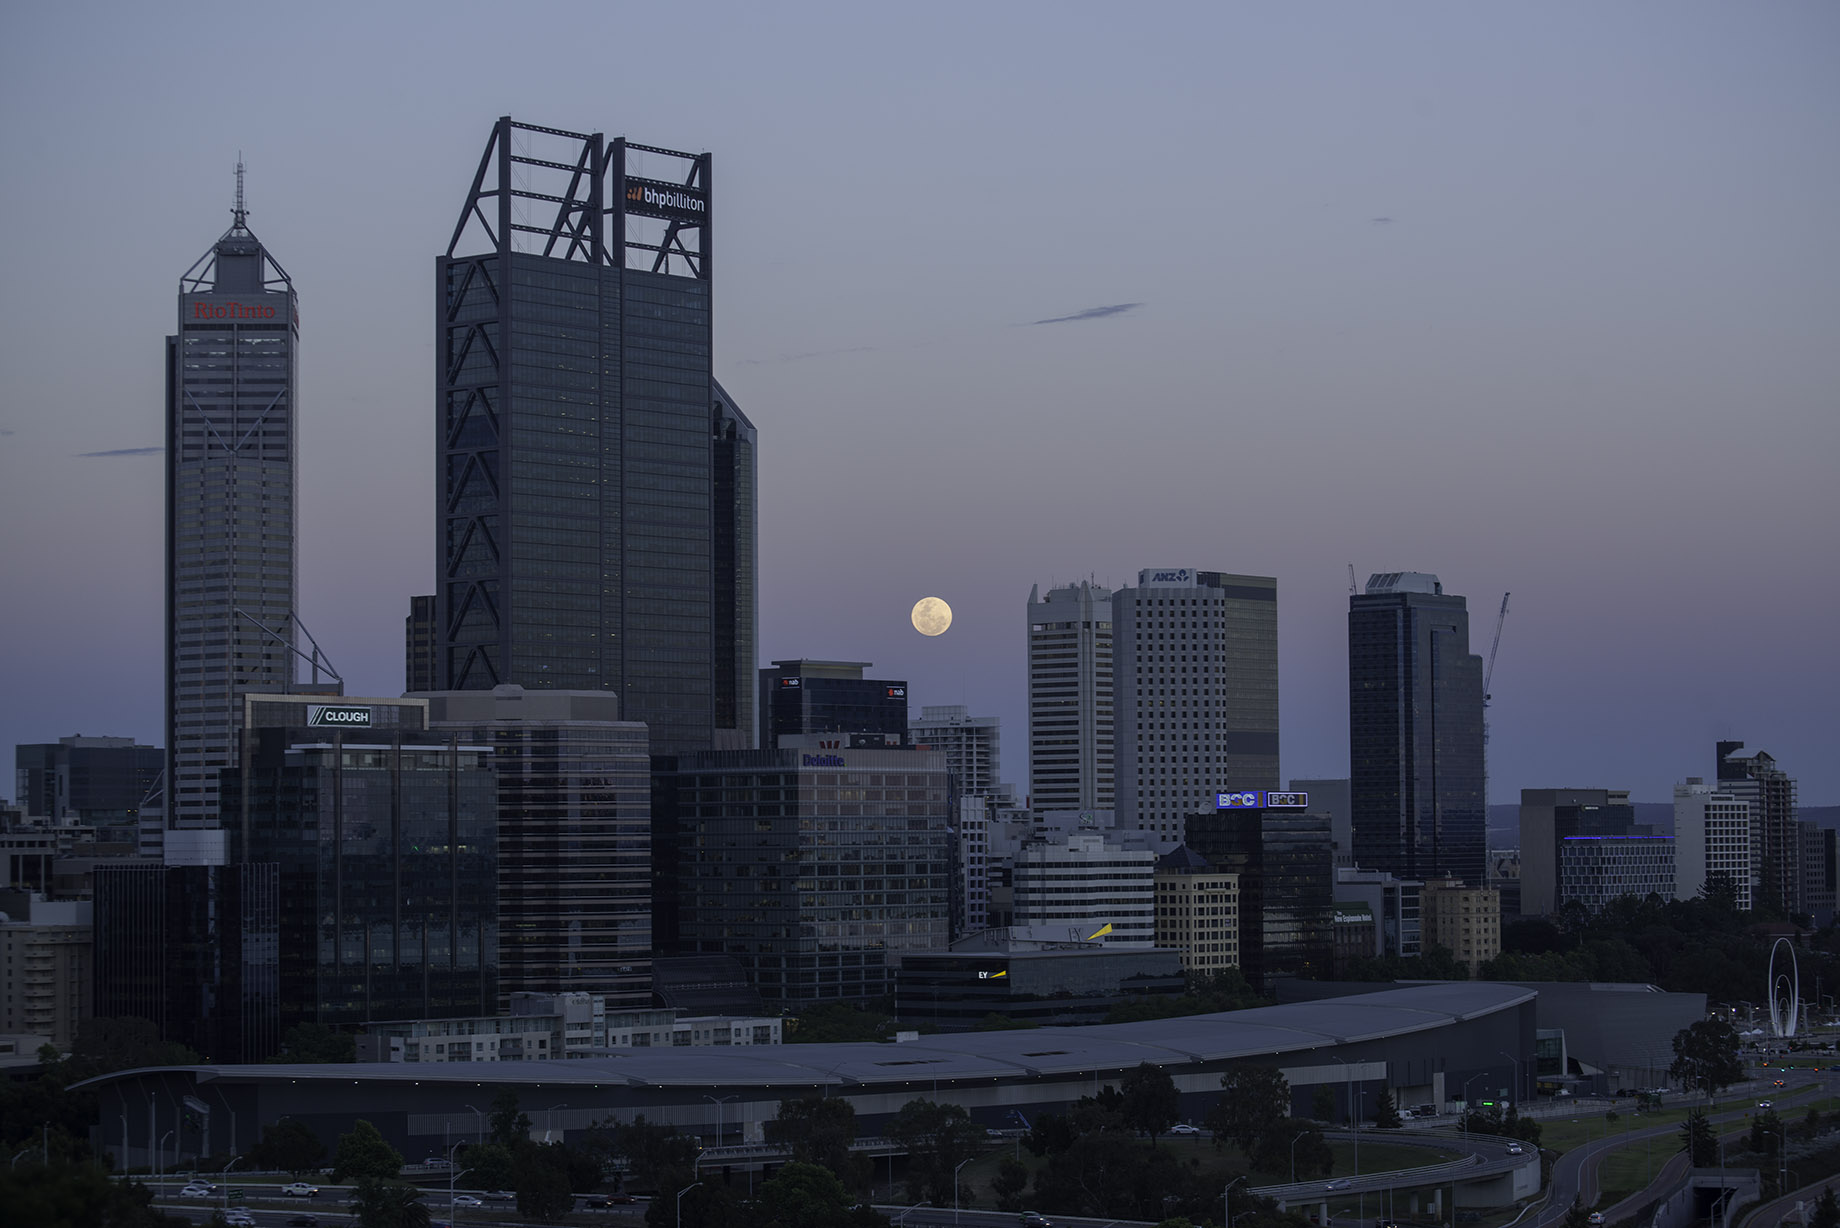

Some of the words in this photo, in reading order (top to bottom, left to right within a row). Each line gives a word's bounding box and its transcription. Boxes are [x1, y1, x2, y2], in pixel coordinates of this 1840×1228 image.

[1152, 572, 1176, 581] ANZ
[325, 711, 368, 722] CLOUGH
[1219, 793, 1255, 806] BGC
[1271, 794, 1296, 805] BGC
